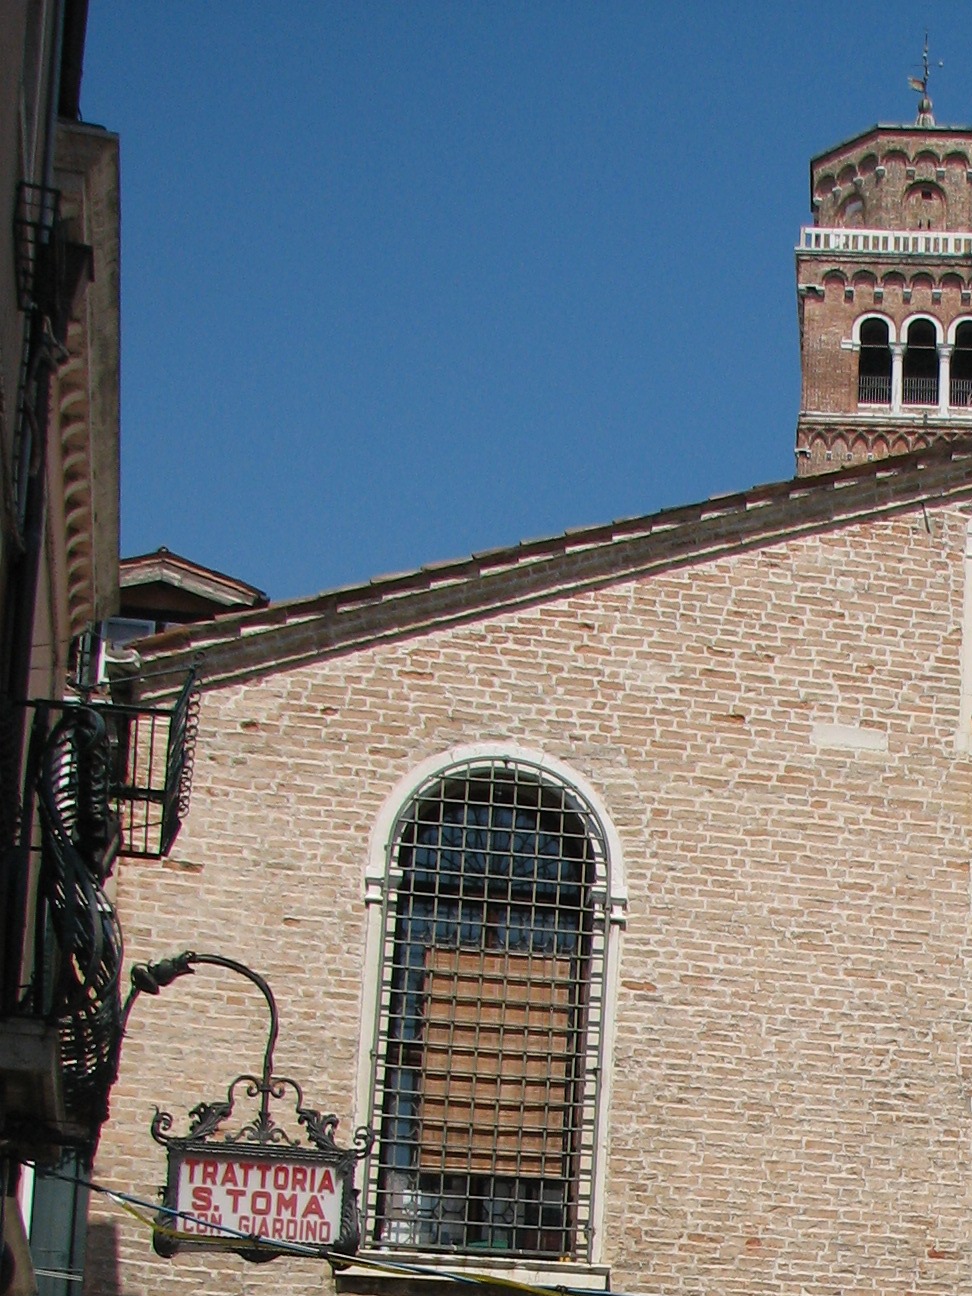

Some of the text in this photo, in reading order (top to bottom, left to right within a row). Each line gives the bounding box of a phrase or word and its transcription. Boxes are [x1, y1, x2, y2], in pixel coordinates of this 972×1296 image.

[185, 1158, 335, 1194] TRATTORIA
[182, 1211, 332, 1243] CON GIARDINO
